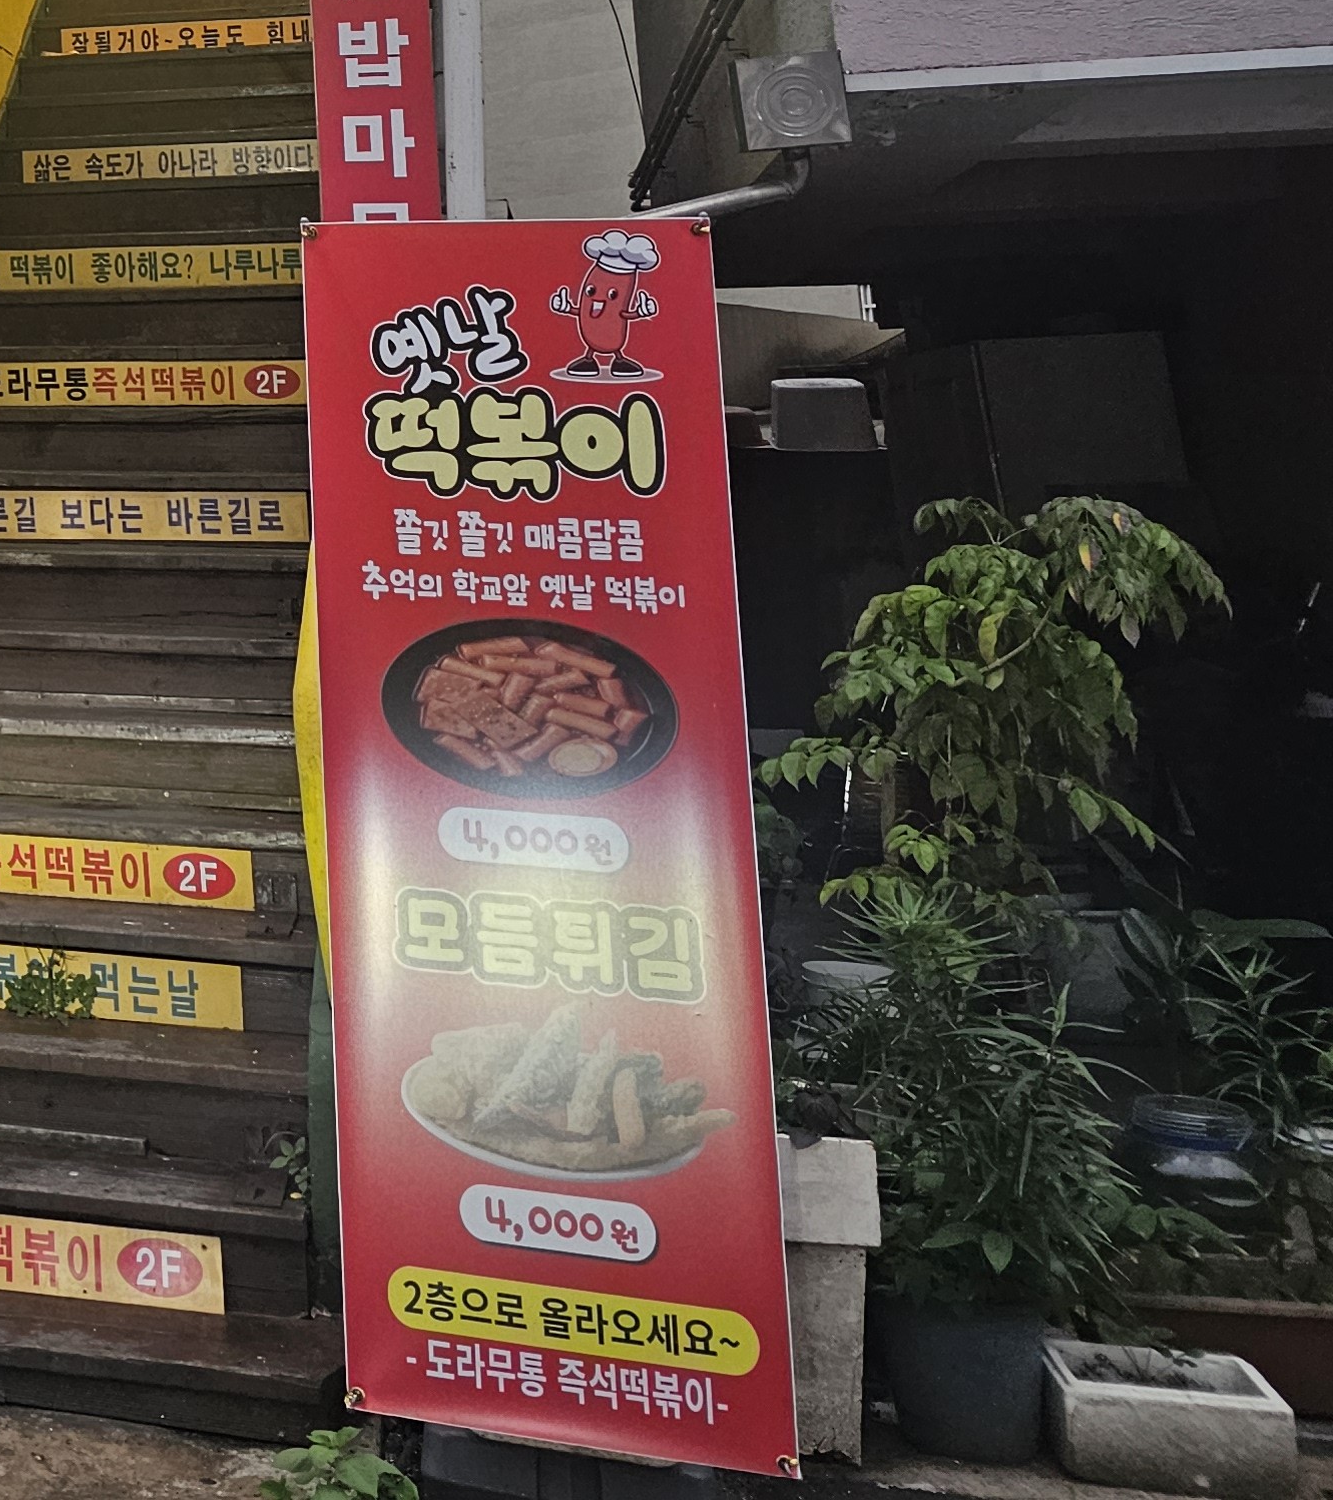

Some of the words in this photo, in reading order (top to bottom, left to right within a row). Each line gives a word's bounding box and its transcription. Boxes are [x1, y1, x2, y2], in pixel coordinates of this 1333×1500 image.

[85, 150, 144, 180] 속도가
[233, 143, 313, 175] 방향이다
[10, 253, 74, 285] 떡볶이
[91, 251, 193, 284] 좋아해요?
[375, 289, 525, 395] 옛날
[255, 370, 287, 395] 2F
[367, 389, 661, 497] 떡볶이
[60, 497, 143, 534] 보다는
[167, 498, 284, 535] 바른길로
[393, 508, 449, 556] 쫄깃
[457, 509, 514, 558] 쫄깃
[524, 516, 644, 563] 매콤달콤
[361, 560, 443, 600] 추억의
[452, 567, 530, 607] 학교앞
[539, 572, 596, 611] 옛날
[604, 574, 685, 614] 떡볶이
[178, 860, 218, 893] 2F
[136, 1246, 182, 1288] 2F
[402, 1280, 527, 1330] 2층으로
[538, 1297, 741, 1357] 올라오세요~
